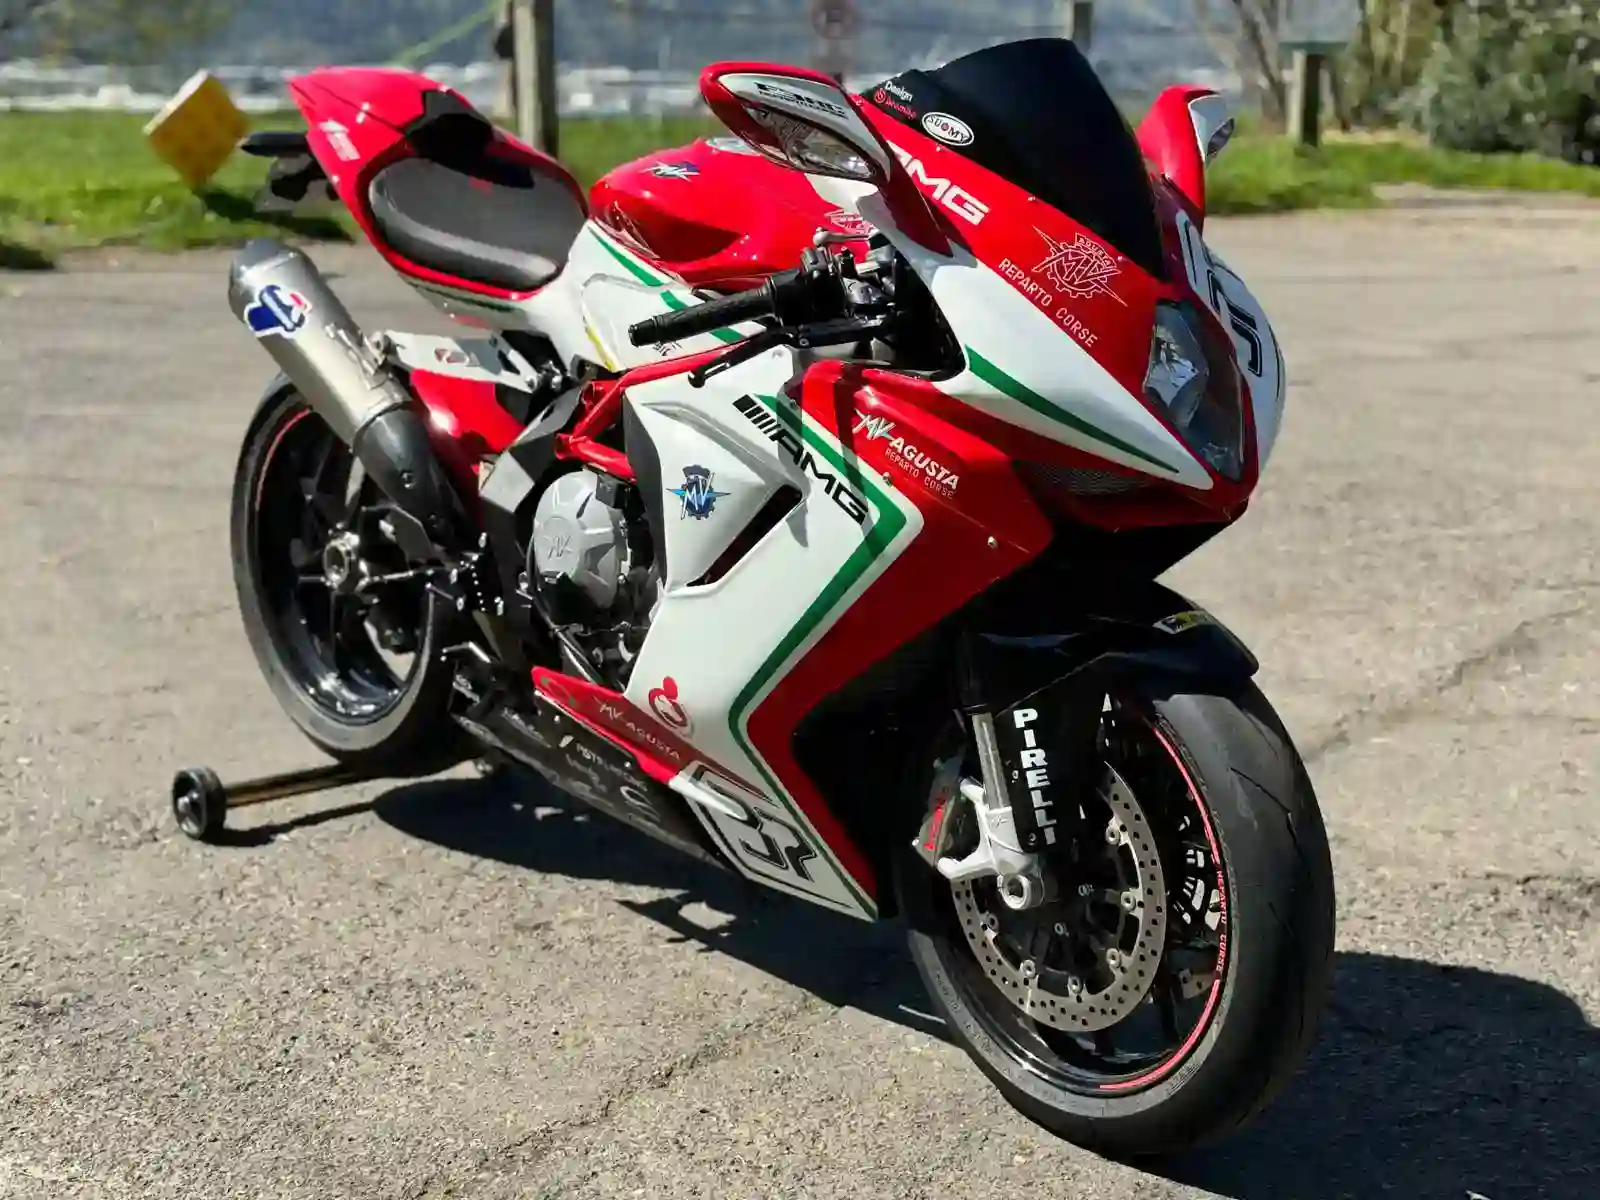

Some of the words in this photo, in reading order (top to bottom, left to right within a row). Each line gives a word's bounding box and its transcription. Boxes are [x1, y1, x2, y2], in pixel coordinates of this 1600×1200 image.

[884, 80, 914, 102] Design
[927, 115, 971, 143] SUOMY
[998, 257, 1053, 307] REPARTO
[1055, 307, 1098, 347] CORSE
[766, 427, 869, 526] AMG
[884, 447, 920, 478] REPARTO
[923, 475, 957, 500] CORSE
[889, 436, 960, 490] AGUSTA
[1013, 707, 1058, 846] PIRELLI
